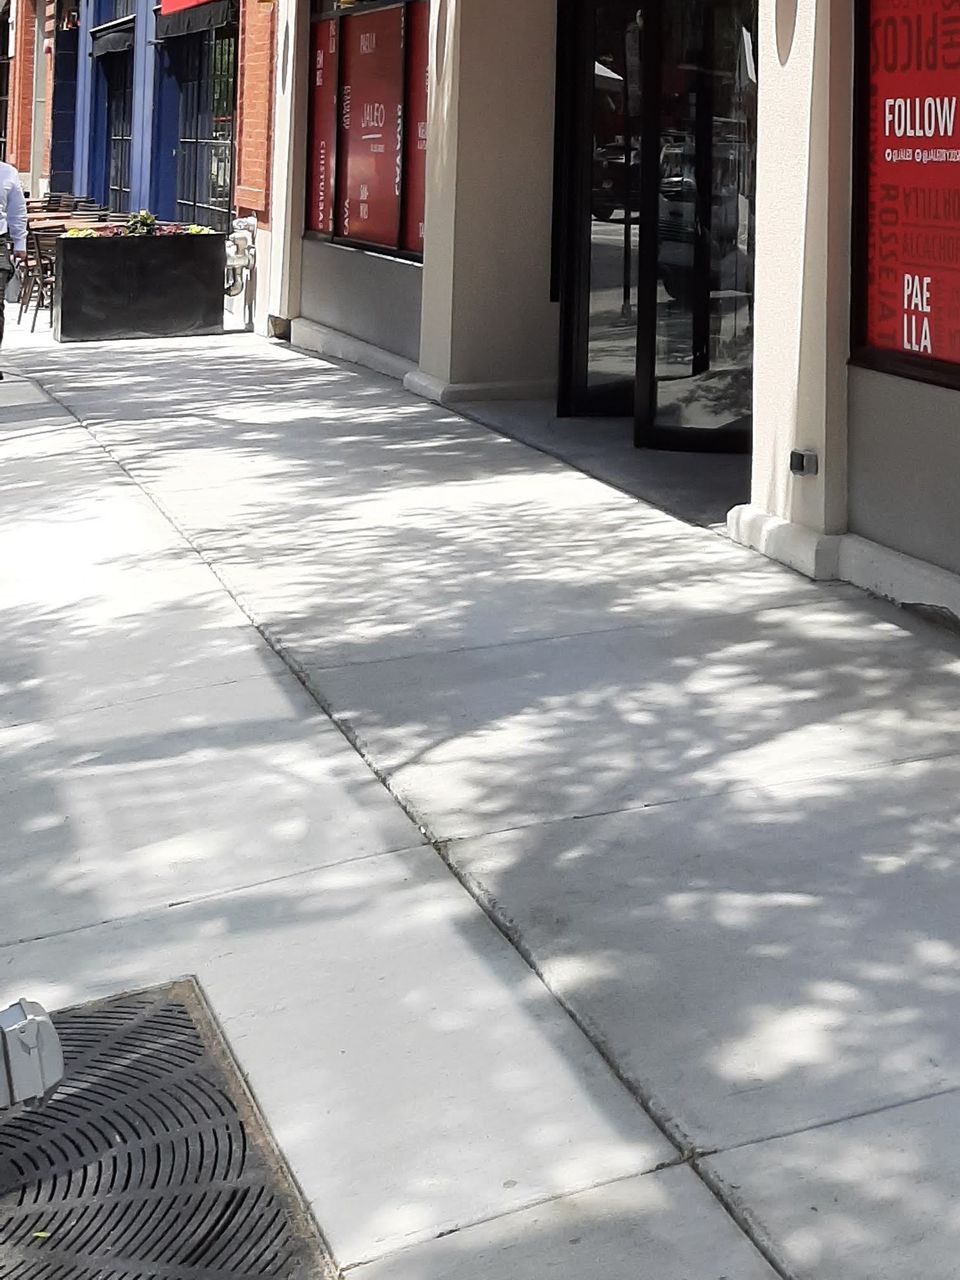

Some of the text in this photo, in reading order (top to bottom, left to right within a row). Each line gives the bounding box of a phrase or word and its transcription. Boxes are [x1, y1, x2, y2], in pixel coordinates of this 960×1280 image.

[361, 103, 386, 128] JALEO
[884, 96, 956, 138] FOLLOW
[903, 273, 932, 313] PAE
[903, 313, 933, 355] LLA
